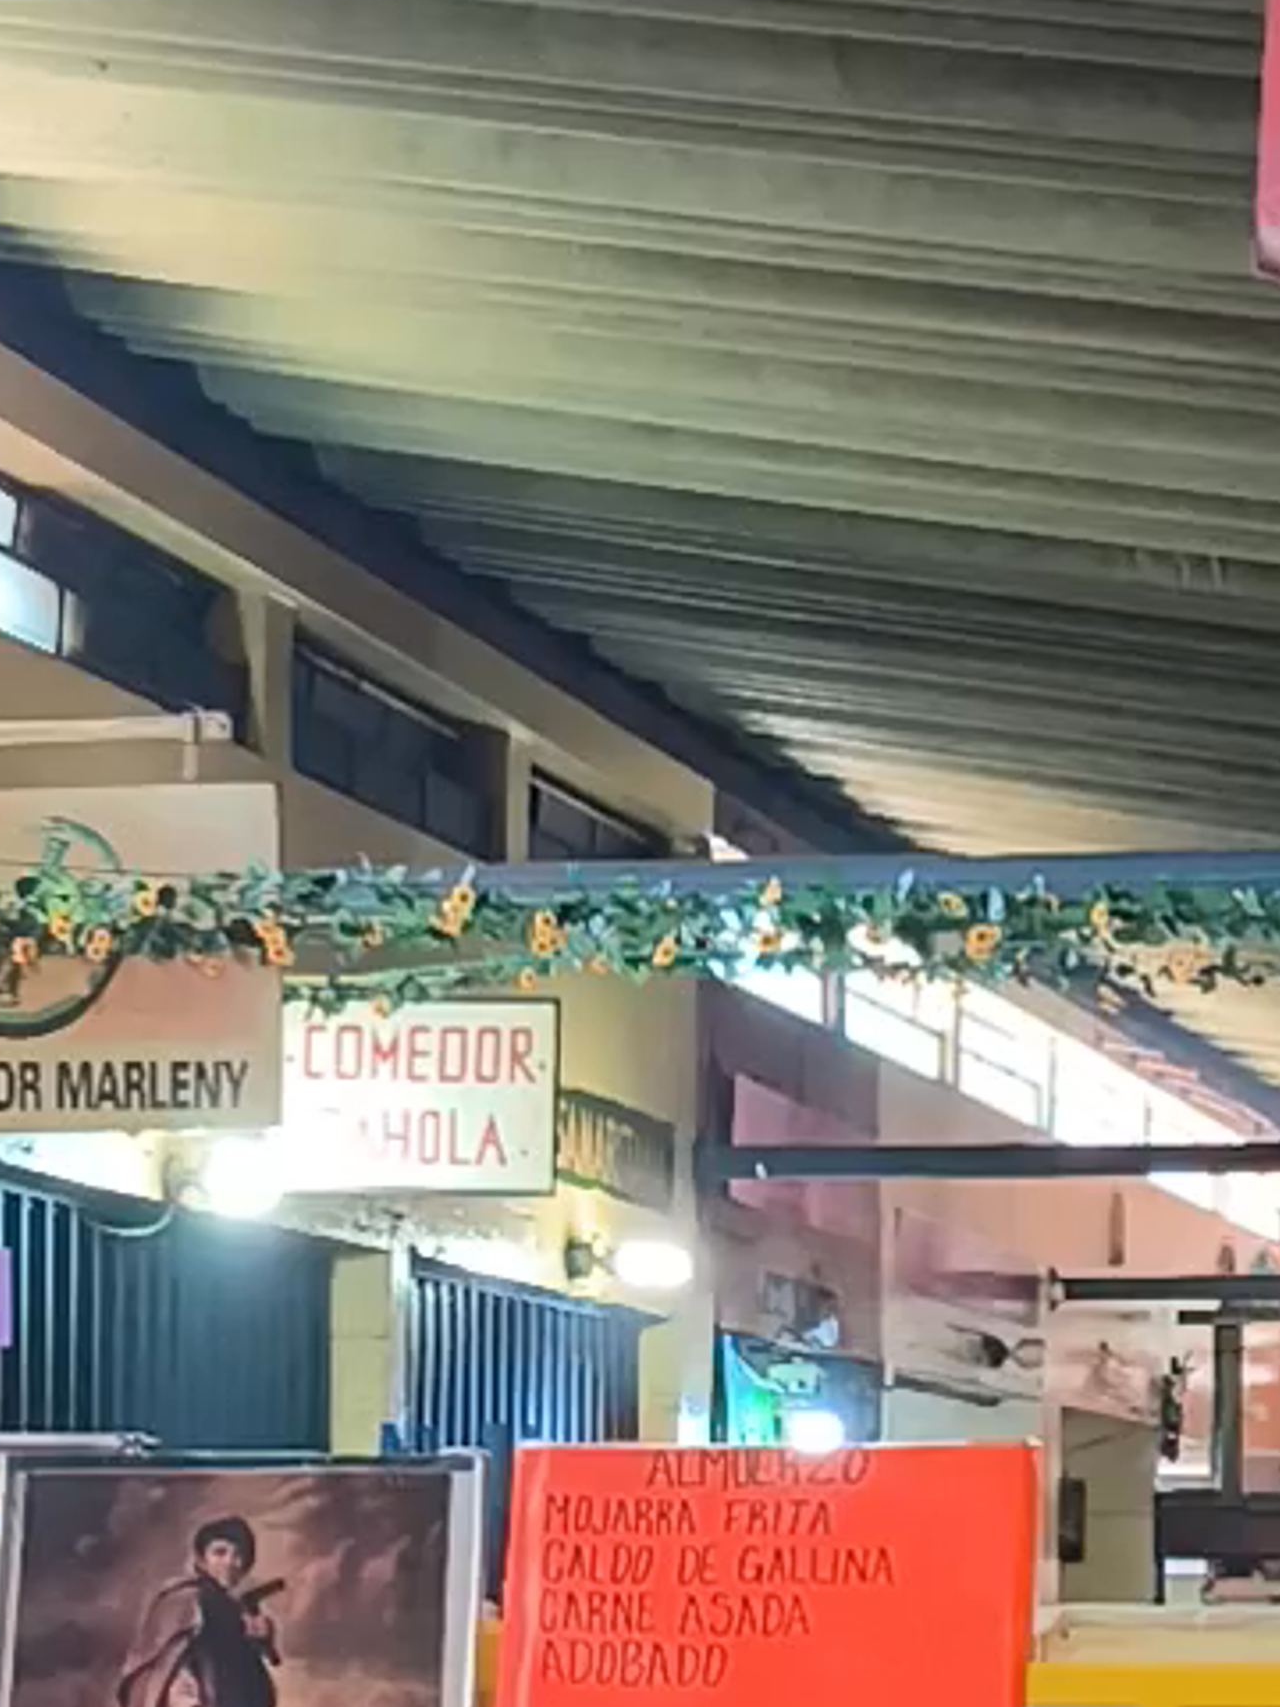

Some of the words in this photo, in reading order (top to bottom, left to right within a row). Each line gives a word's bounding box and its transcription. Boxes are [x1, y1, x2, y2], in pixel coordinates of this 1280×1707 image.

[304, 1025, 537, 1083] COMEDOR
[55, 1060, 248, 1111] MARLENY
[543, 1494, 695, 1536] MOJARRA
[724, 1498, 831, 1536] FRITA
[542, 1539, 654, 1585] CALDO
[677, 1545, 717, 1586] DE
[737, 1545, 894, 1586] GALLINA
[539, 1589, 655, 1633] CARNE
[678, 1592, 810, 1637] ASADA
[542, 1639, 728, 1688] ADOBADO
